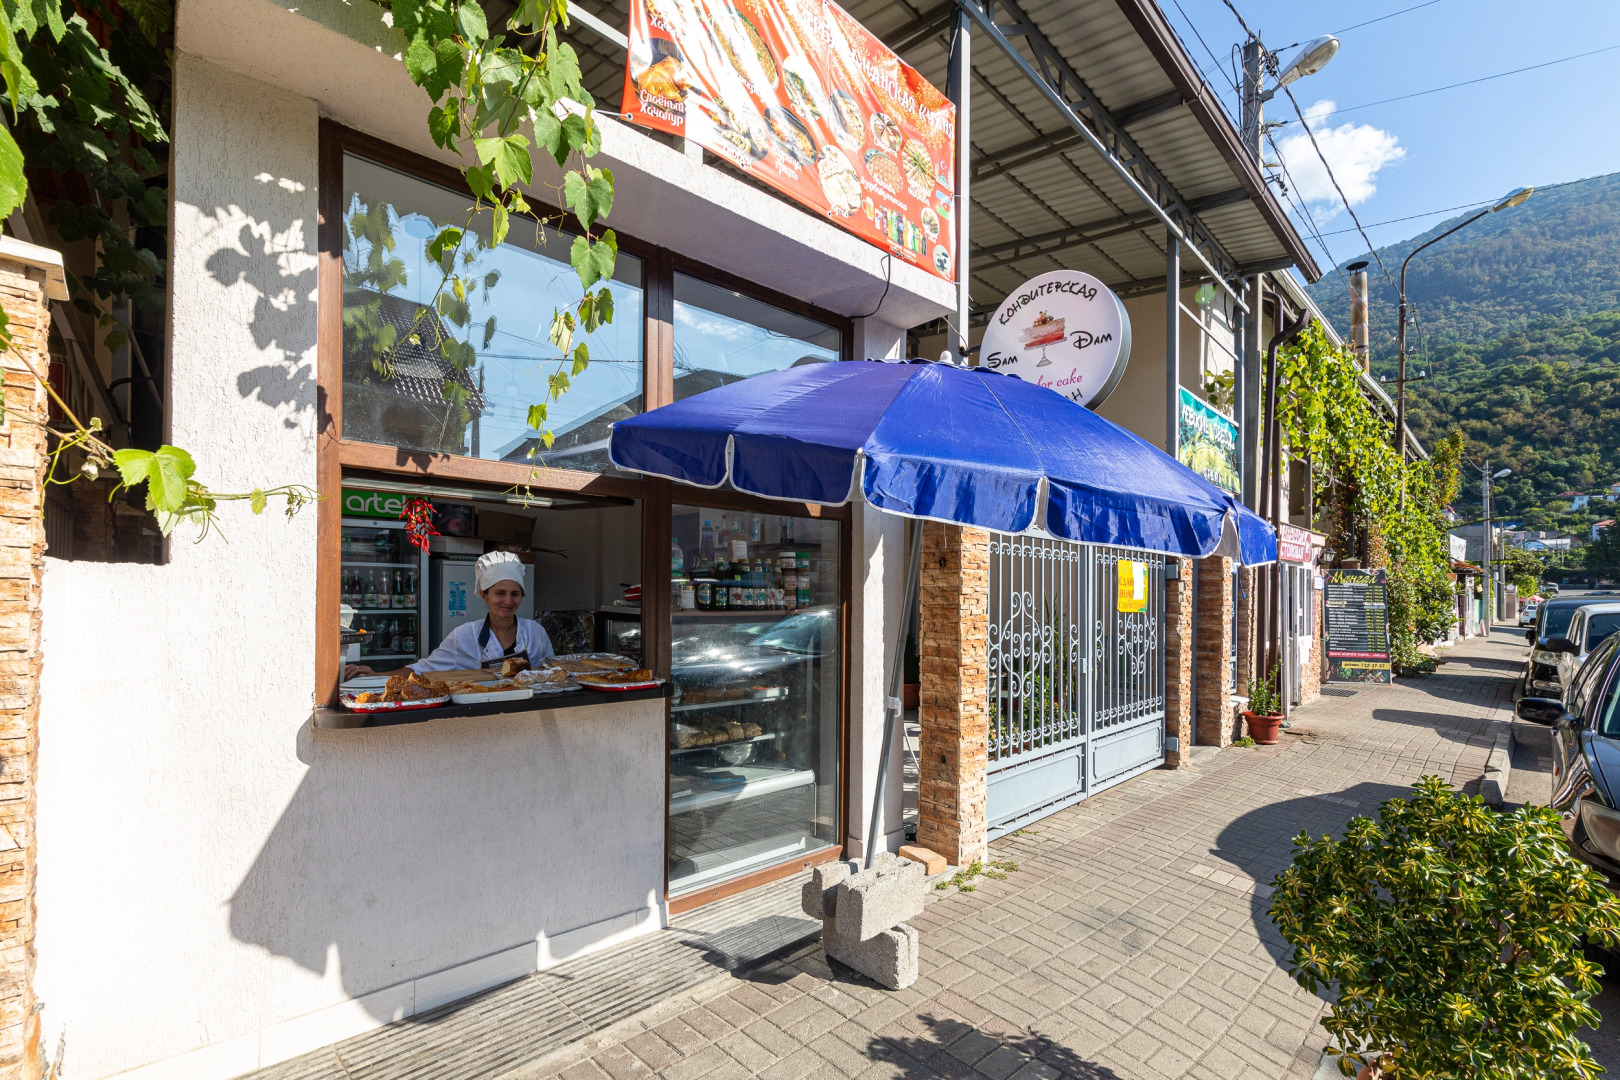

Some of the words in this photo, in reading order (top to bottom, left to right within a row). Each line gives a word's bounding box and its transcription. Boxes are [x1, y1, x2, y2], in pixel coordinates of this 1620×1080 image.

[640, 89, 686, 113] Слоёный
[999, 280, 1097, 325] КОНДИТЕРСКАЯ
[1056, 368, 1083, 387] cake
[346, 493, 406, 514] artel
[1331, 571, 1378, 585] Мангал
